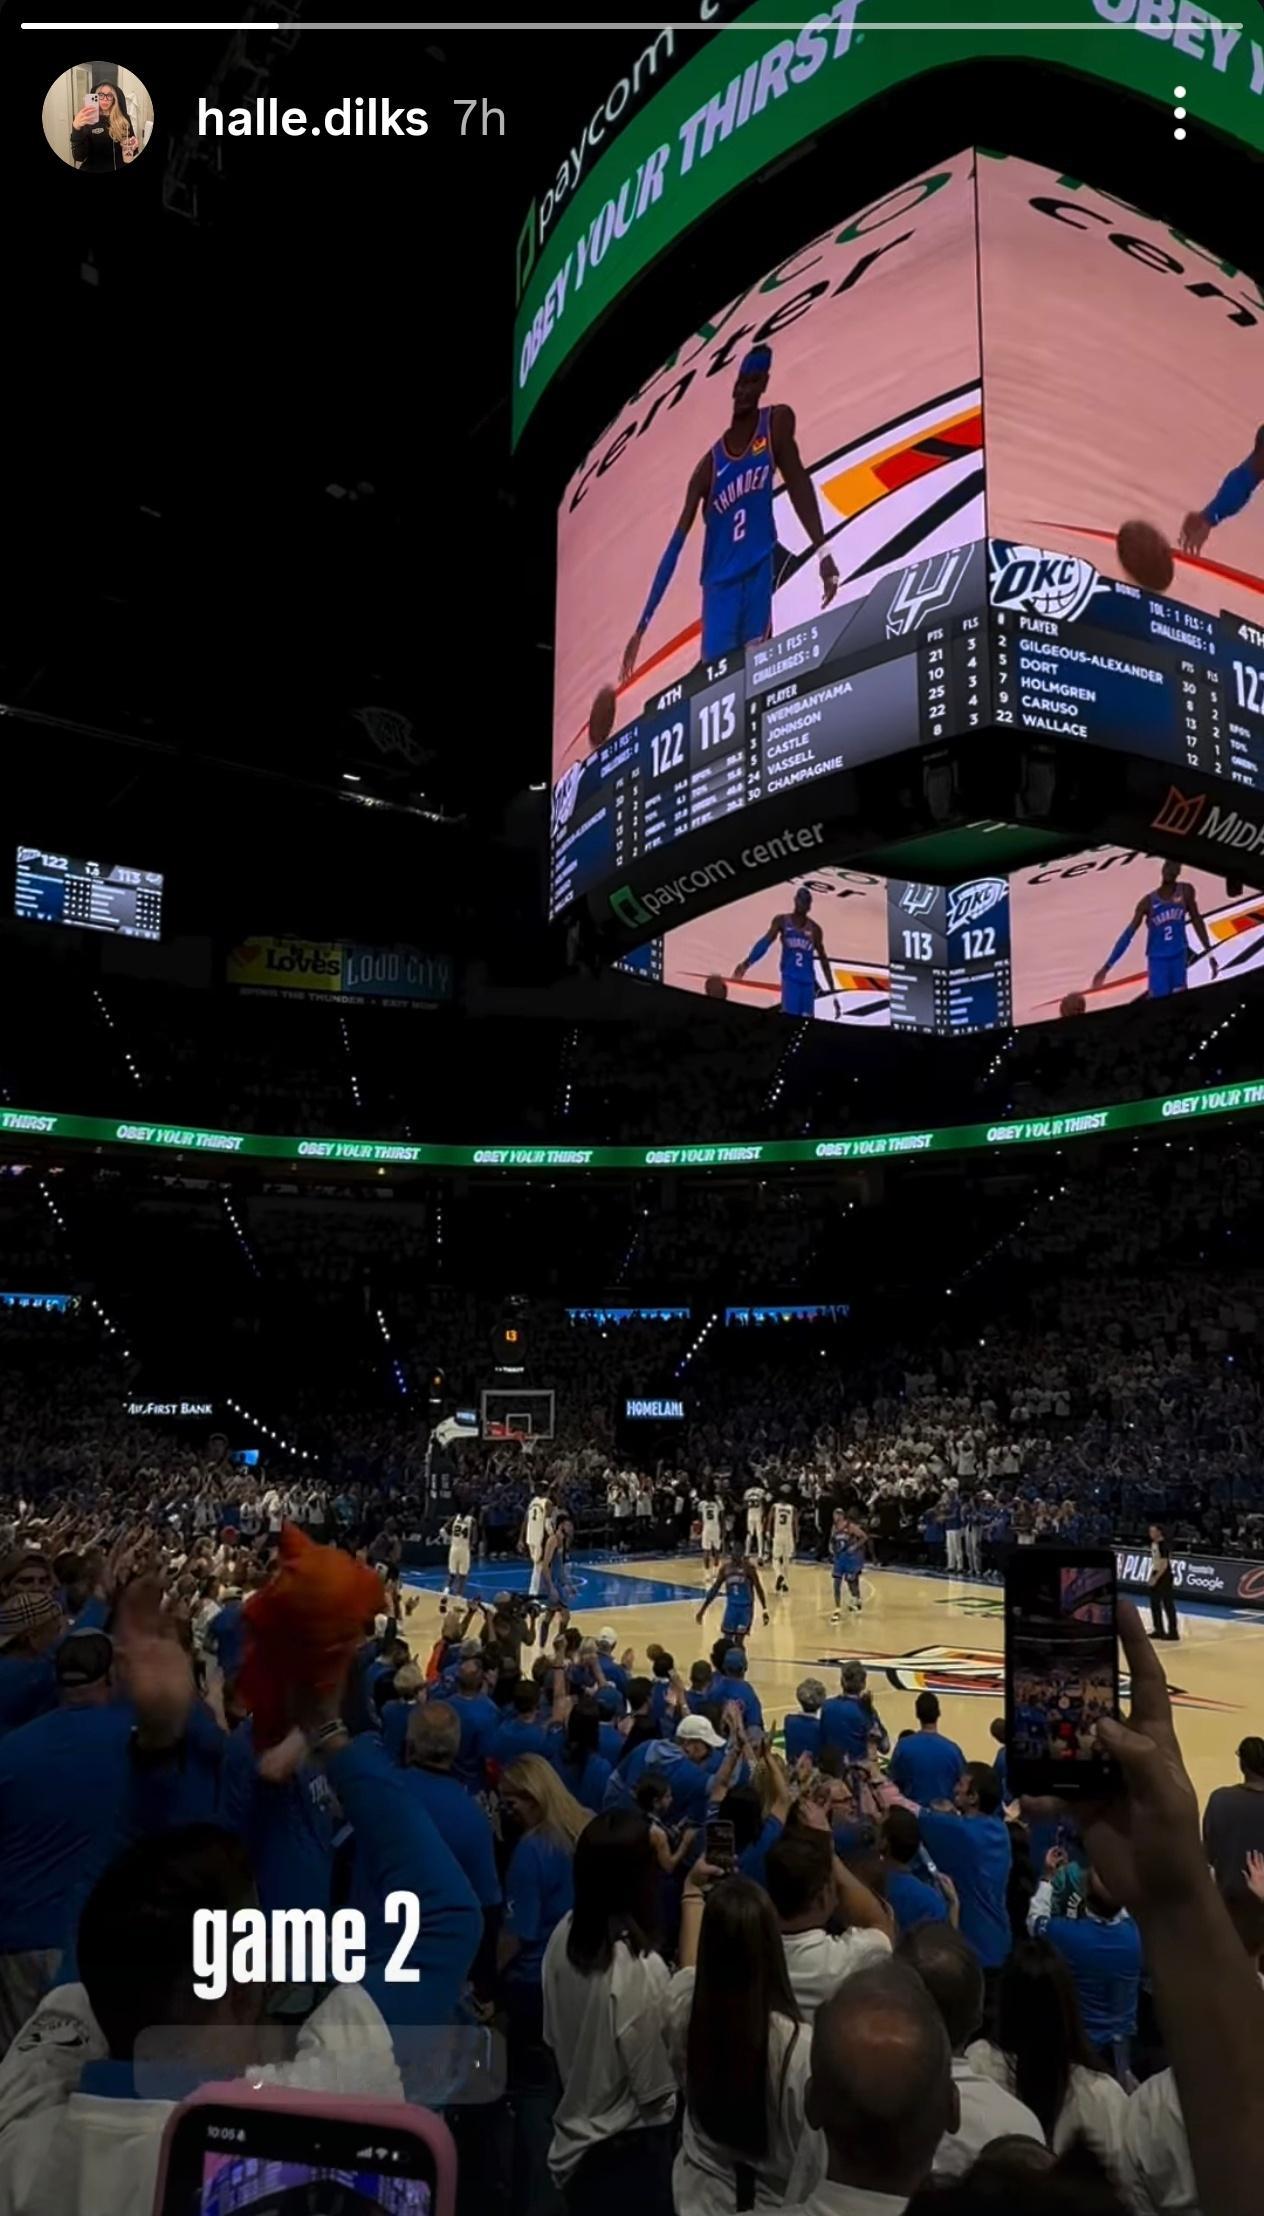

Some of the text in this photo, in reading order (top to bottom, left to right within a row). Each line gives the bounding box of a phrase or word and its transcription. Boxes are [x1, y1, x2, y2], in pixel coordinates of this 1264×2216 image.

[538, 26, 674, 246] paycom
[519, 252, 573, 389] OBEY
[575, 143, 671, 292] YOUR
[713, 464, 769, 514] THUNDER
[733, 508, 746, 542] 2
[992, 559, 1074, 604] OKC
[811, 626, 818, 640] 5
[927, 628, 943, 642] PTS
[962, 617, 979, 631] FLS
[1020, 616, 1059, 637] PLAYER
[1150, 620, 1208, 652] CHALLENGES:
[1206, 622, 1213, 636] 4
[706, 658, 728, 682] 1.5
[752, 651, 811, 685] CHALLENGES:
[998, 635, 1218, 703] 2 GILGEOUS-ALEXANDER 30 5
[657, 684, 683, 711] 4TH
[751, 721, 757, 732] 1
[766, 682, 854, 724] WEMBANYAMA
[928, 648, 944, 663] 21
[967, 638, 977, 650] 3
[766, 684, 797, 707] PLAYER
[998, 653, 1219, 721] 5 DORT 8 2
[1232, 660, 1264, 715] 12
[750, 656, 977, 750] 3 JOHNSON 10 4
[999, 672, 1220, 739] 7 HOLMGREN 13 2
[698, 692, 736, 751] 113
[750, 675, 977, 766] 5 CASTLE 25 3
[999, 690, 1220, 756] 9 CARUSO 17 1
[650, 722, 685, 778] 122
[747, 694, 978, 785] 24 VASSELL 22 4
[996, 710, 1222, 774] 22 WALLACE 12 2
[747, 713, 979, 801] 30 CHAMPAGNIE 8 3
[41, 854, 69, 871] 122
[118, 868, 141, 884] 113
[641, 823, 825, 915] paycom center
[902, 929, 933, 962] 113
[961, 926, 996, 961] 122
[1163, 926, 1173, 941] 2
[346, 953, 450, 993] LOUD CITY
[795, 952, 803, 967] 2
[309, 992, 365, 1006] THUNDER
[1162, 1099, 1201, 1117] OBEY
[1202, 1090, 1242, 1110] YOUR
[2, 1113, 57, 1132] THIRST
[986, 1111, 1109, 1143] OBEY YOUR THIRST
[117, 1125, 244, 1151] OBEY YOUR THIRST
[298, 1141, 422, 1161] OBEY YOUR THIRST
[815, 1133, 934, 1158] OBEY YOUR THIRST
[473, 1149, 594, 1164] OBEY YOUR THIRST
[645, 1146, 763, 1165] OBEY YOUR THIRST
[532, 1508, 538, 1521] 1
[706, 1509, 714, 1521] 5
[779, 1514, 788, 1526] 3
[453, 1525, 469, 1539] 24
[1186, 1573, 1225, 1592] Google
